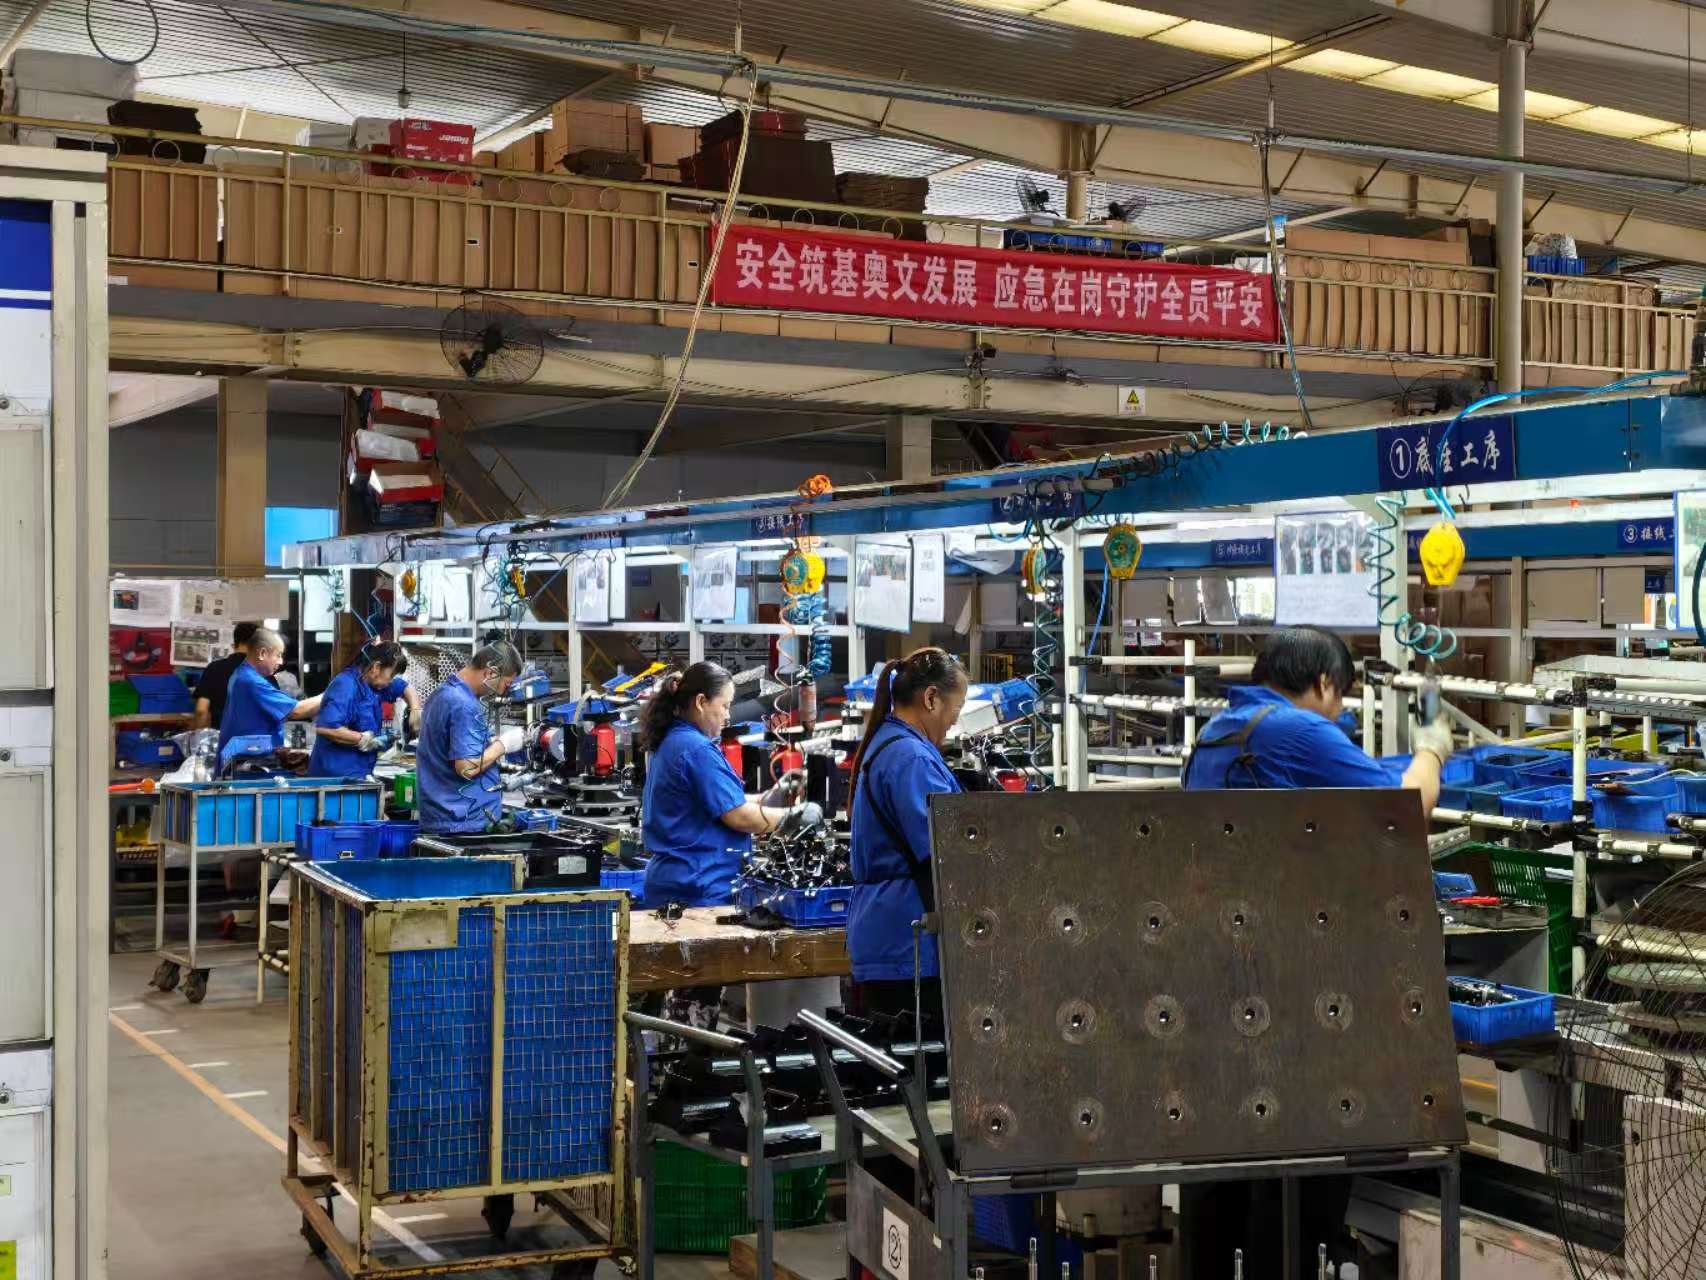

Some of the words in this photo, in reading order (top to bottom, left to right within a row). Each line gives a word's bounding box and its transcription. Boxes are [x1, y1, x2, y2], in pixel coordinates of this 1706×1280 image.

[735, 238, 978, 309] 安全筑基奥文发展
[993, 261, 1264, 329] 应急在岗守护全员平安
